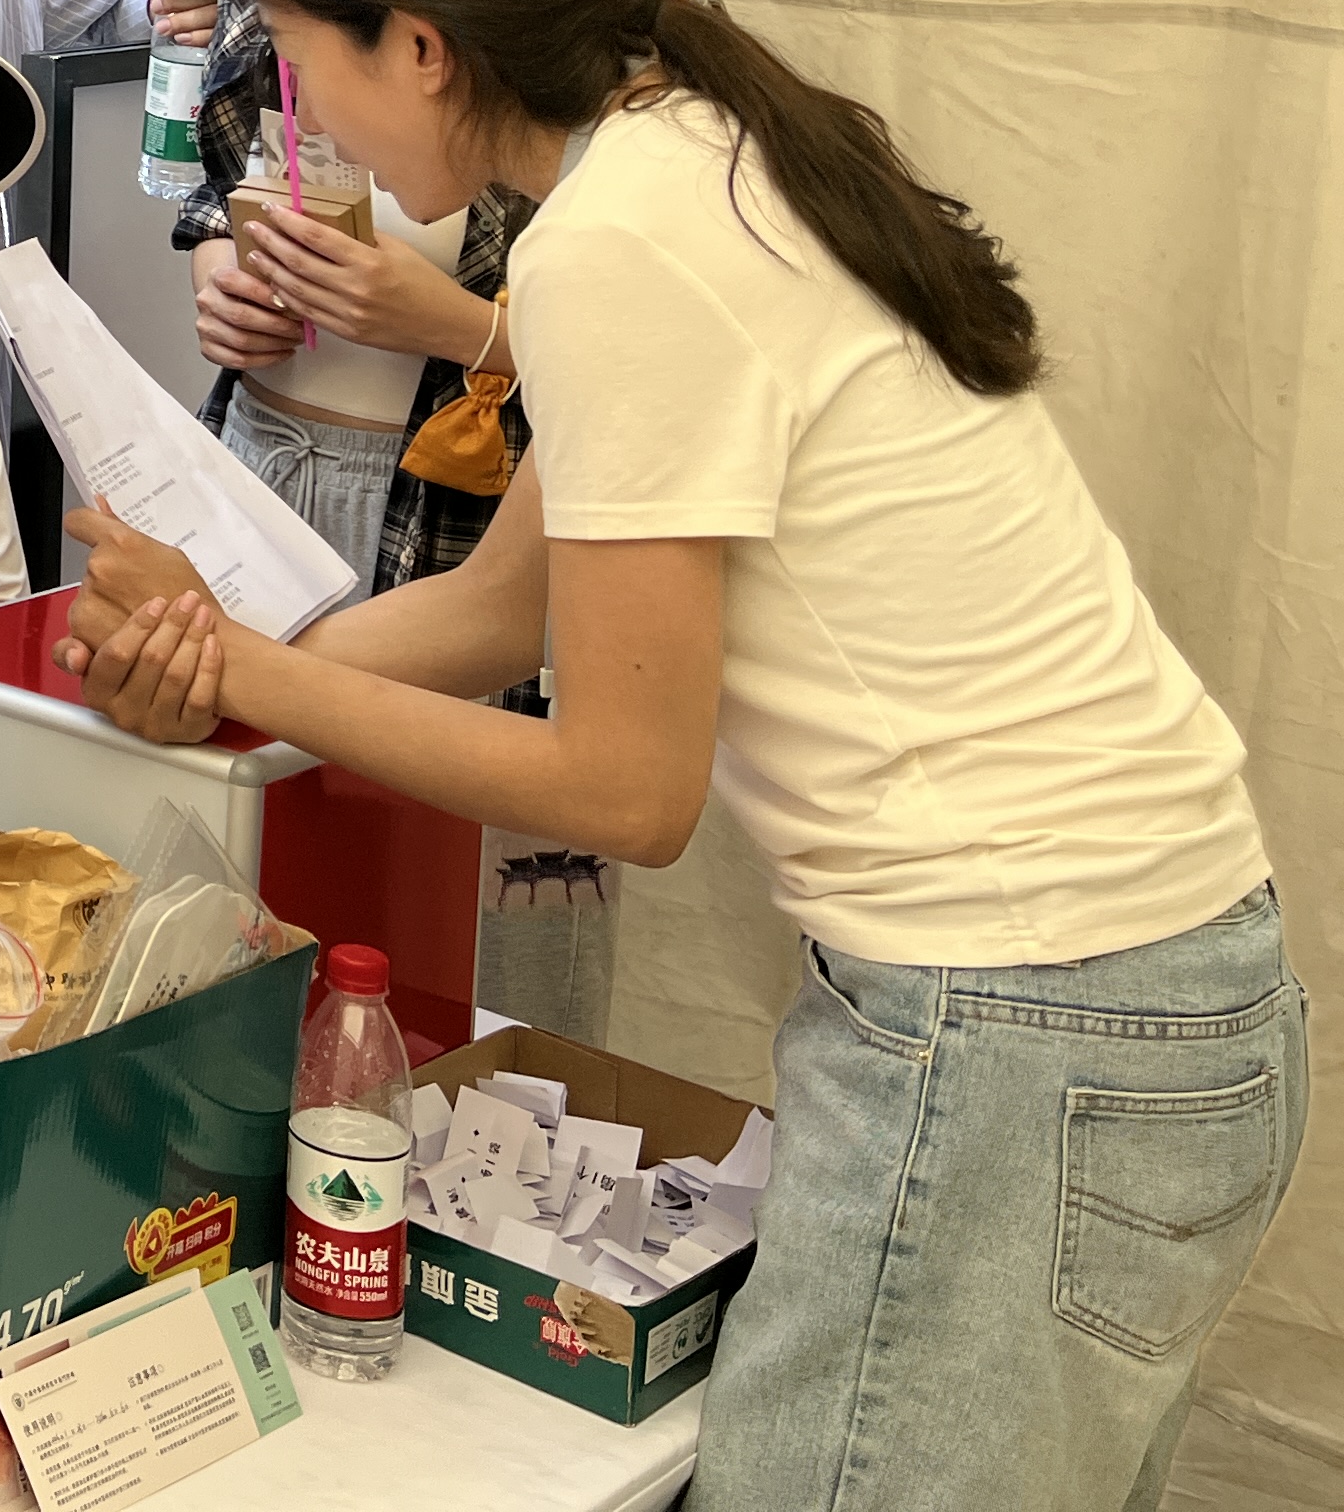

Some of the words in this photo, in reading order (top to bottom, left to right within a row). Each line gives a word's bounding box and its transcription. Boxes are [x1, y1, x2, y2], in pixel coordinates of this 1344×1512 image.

[295, 1230, 390, 1273] 农夫山泉
[295, 1256, 340, 1285] NONGFU
[344, 1274, 389, 1289] SPRING
[407, 1259, 499, 1324] 金旗
